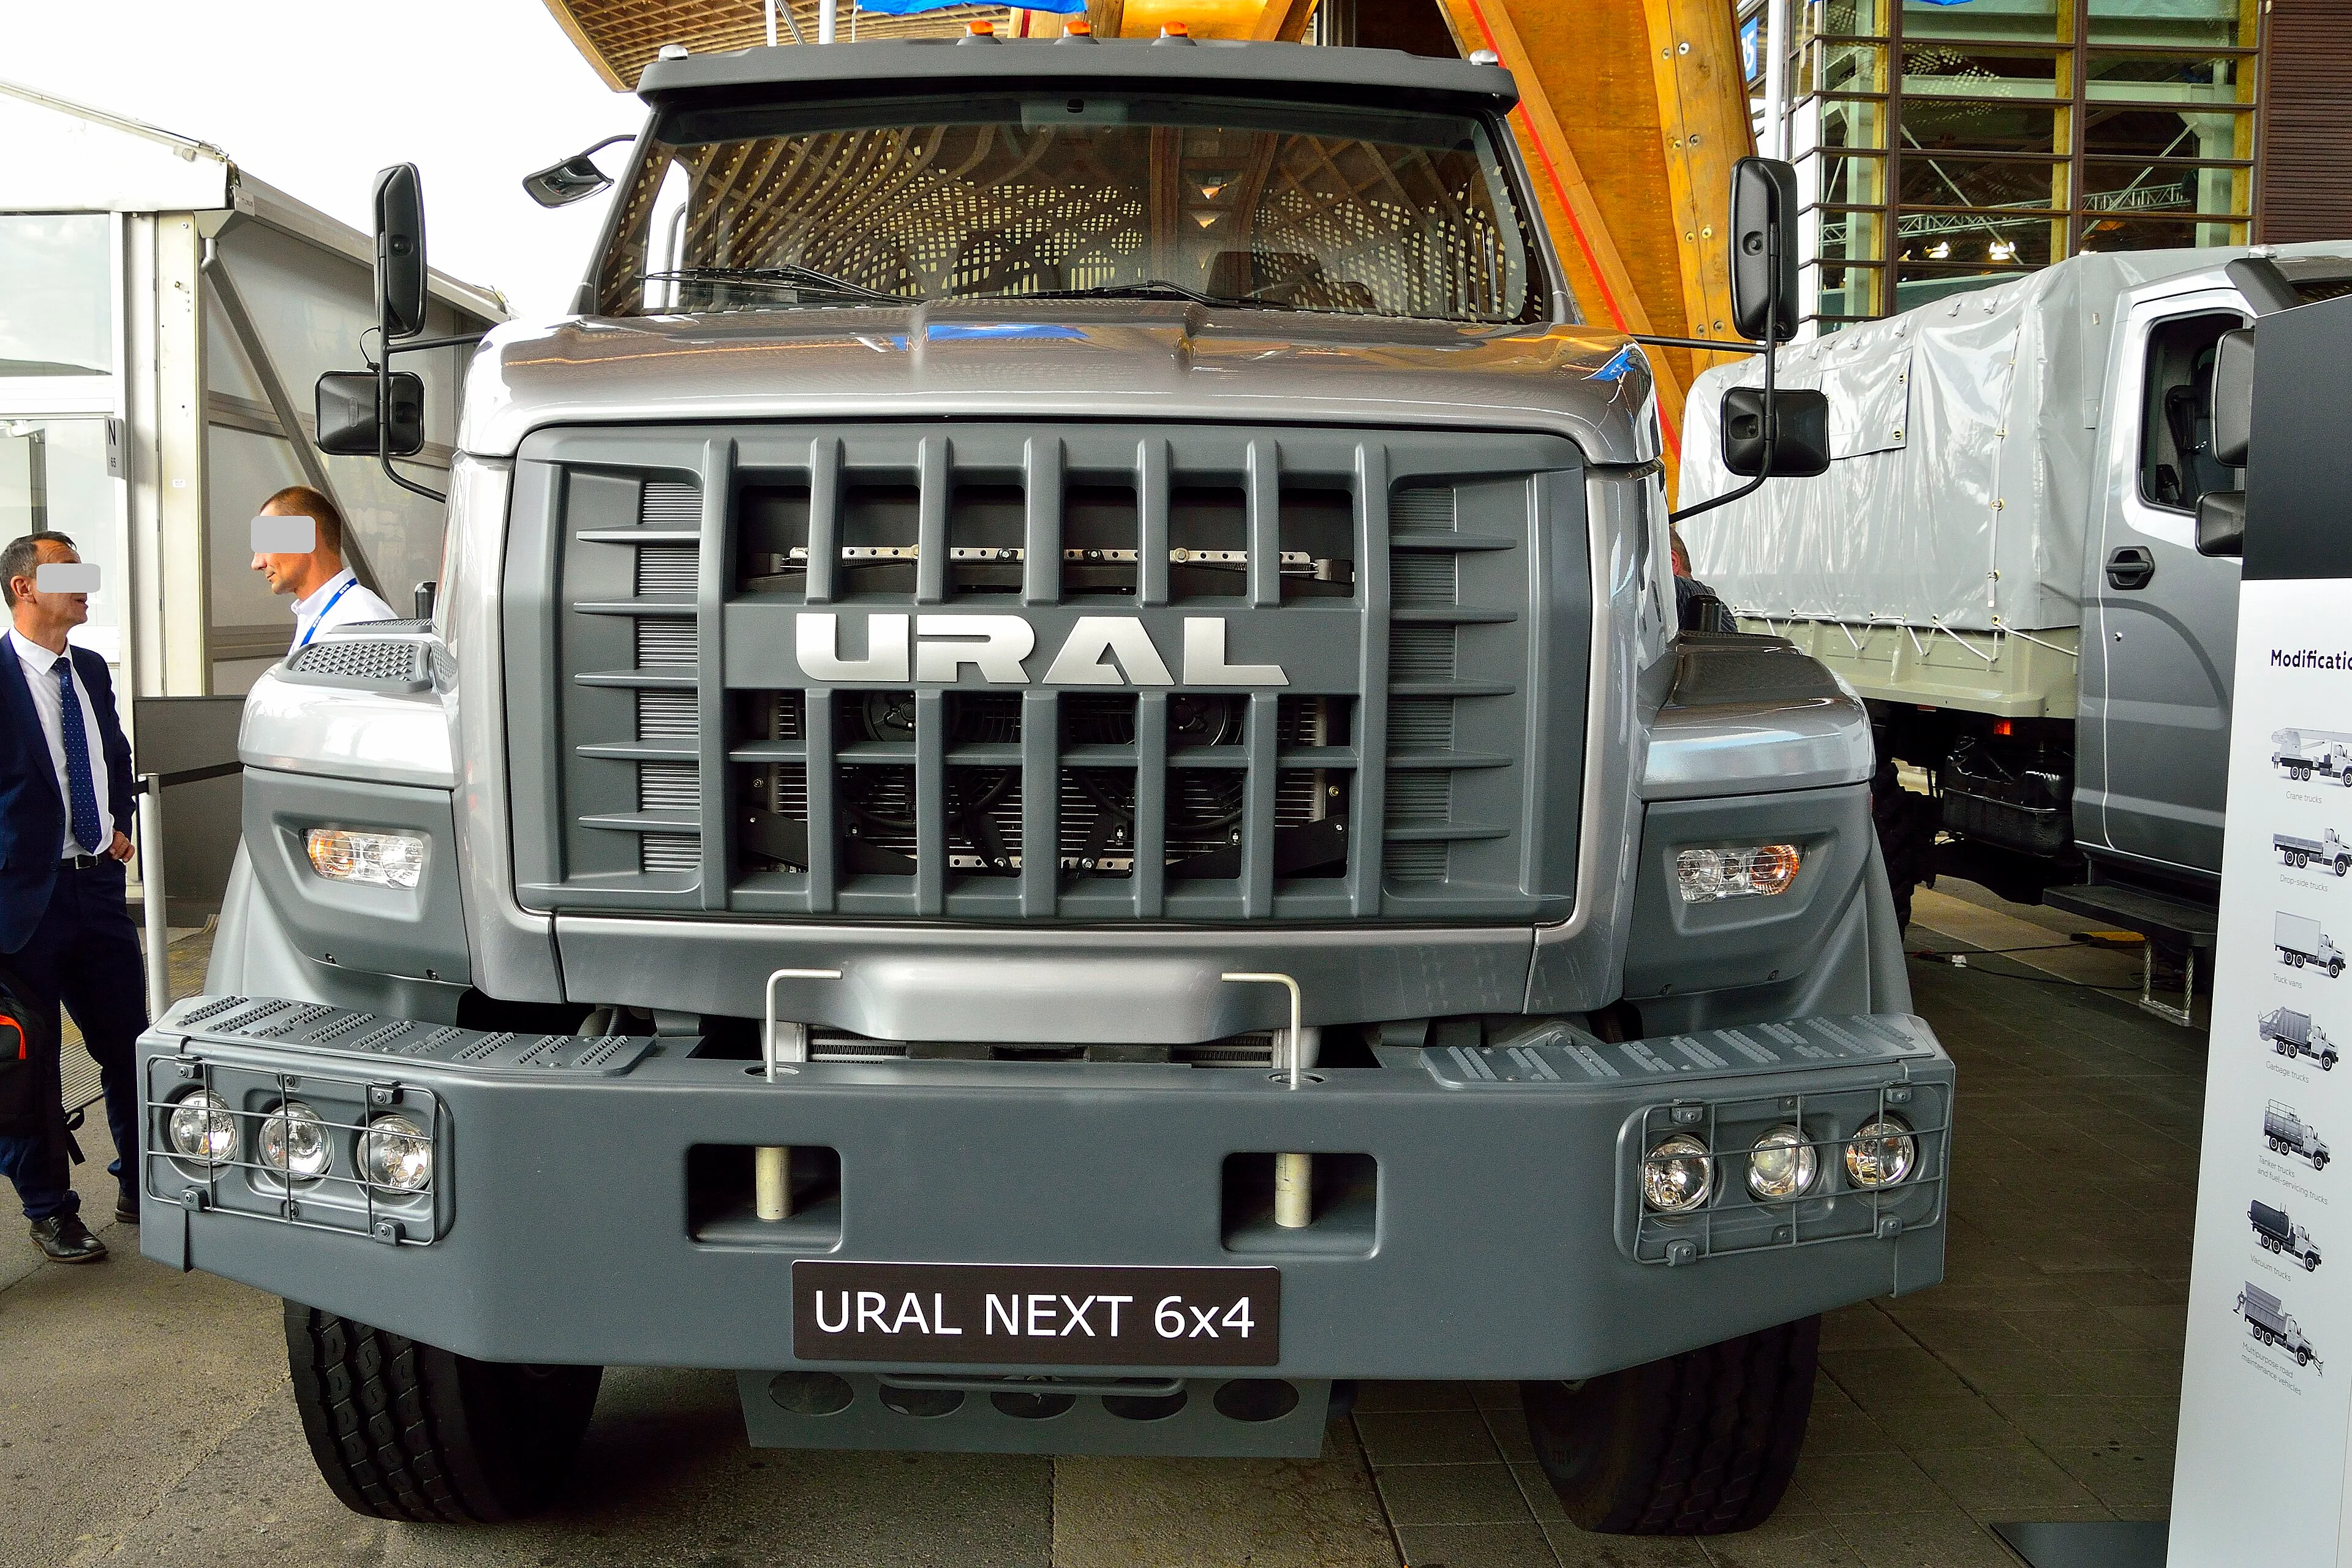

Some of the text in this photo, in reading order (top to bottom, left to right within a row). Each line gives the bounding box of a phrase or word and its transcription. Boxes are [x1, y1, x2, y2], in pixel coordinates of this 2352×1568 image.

[108, 419, 116, 446] N
[796, 612, 1290, 686] URAL
[2286, 791, 2323, 804] Crane trucks
[2280, 874, 2328, 892] Drop-side trucks
[2273, 972, 2303, 989] Truck vans
[2266, 1060, 2309, 1084] Garbage trucks
[2258, 1155, 2296, 1178] Tanker trucks
[2257, 1167, 2328, 1205] and fuel-servicing trucks
[2250, 1253, 2292, 1282] Vacuum trucks
[813, 1290, 1256, 1340] URAL NEXT 6x4
[2242, 1341, 2293, 1379] Multipurpose road
[2241, 1354, 2302, 1396] maintenance vehicles
